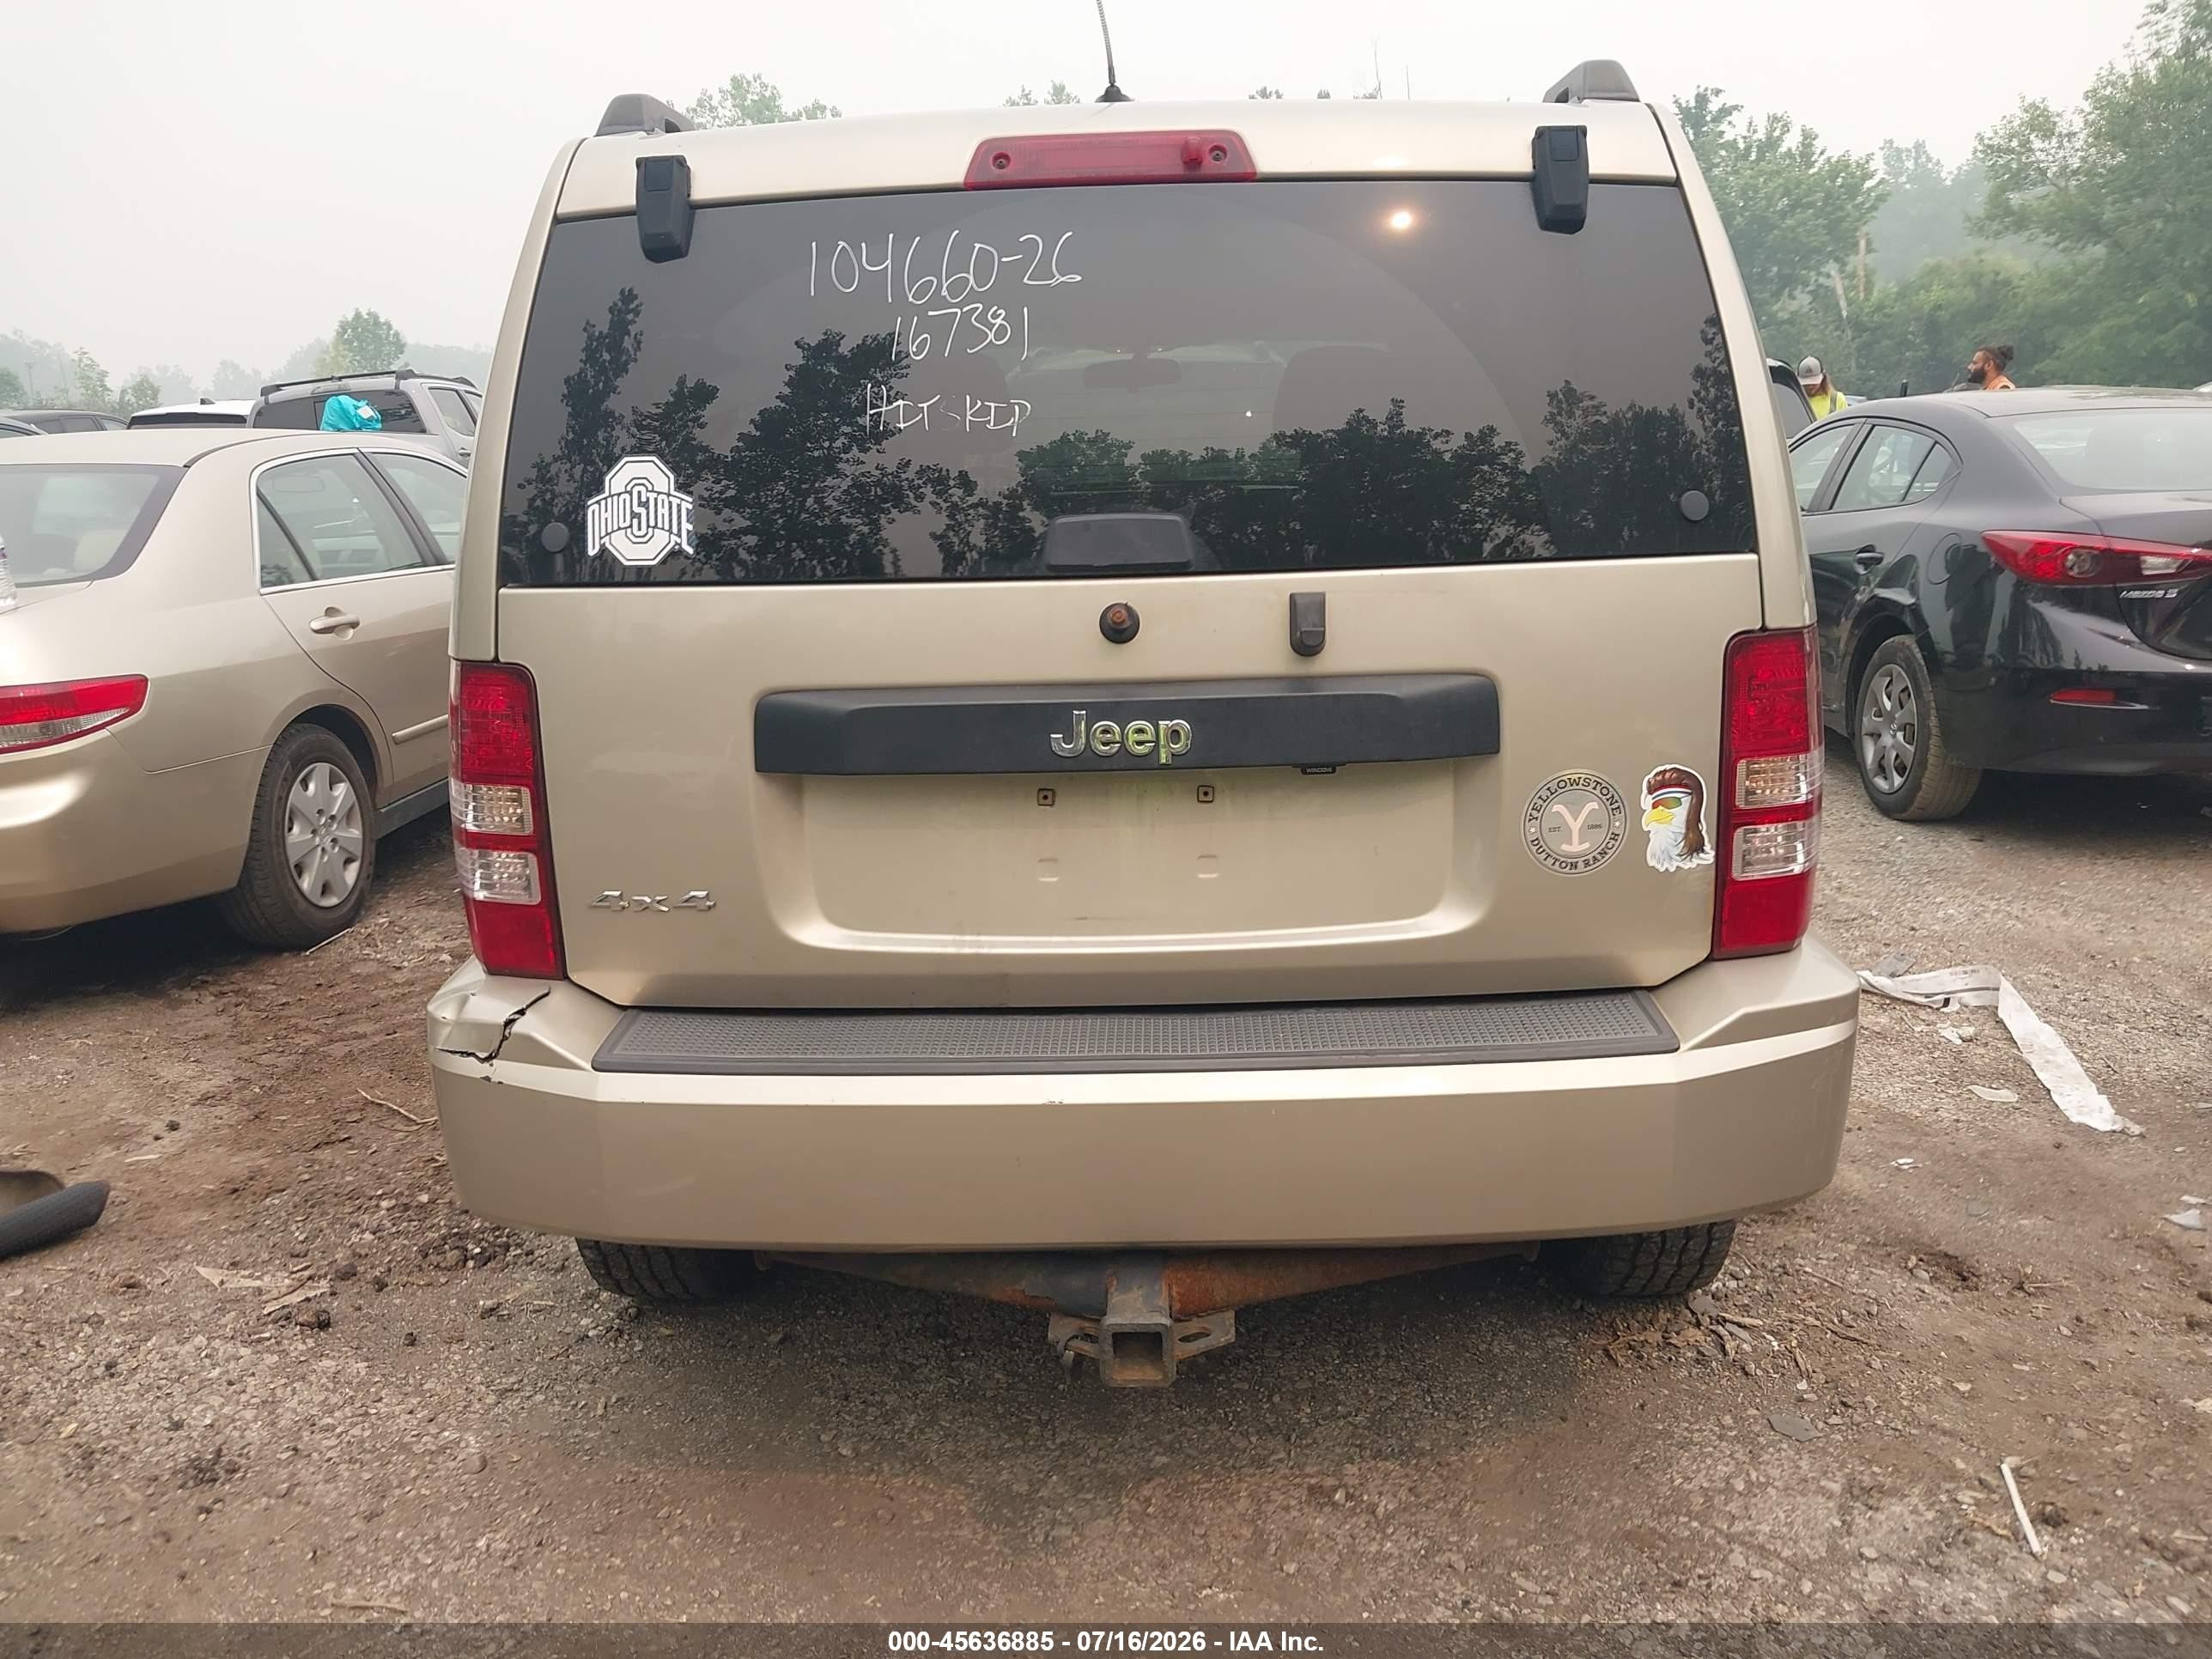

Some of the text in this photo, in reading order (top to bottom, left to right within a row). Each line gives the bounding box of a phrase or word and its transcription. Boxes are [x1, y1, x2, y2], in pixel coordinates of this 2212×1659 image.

[811, 229, 1083, 304] 104660-26
[891, 303, 1028, 361] 167381
[632, 484, 695, 555] STATE
[1049, 710, 1192, 765] Jeep
[1528, 776, 1621, 823] YELLOWSTONE
[1530, 831, 1620, 871] DUTTON RANCH
